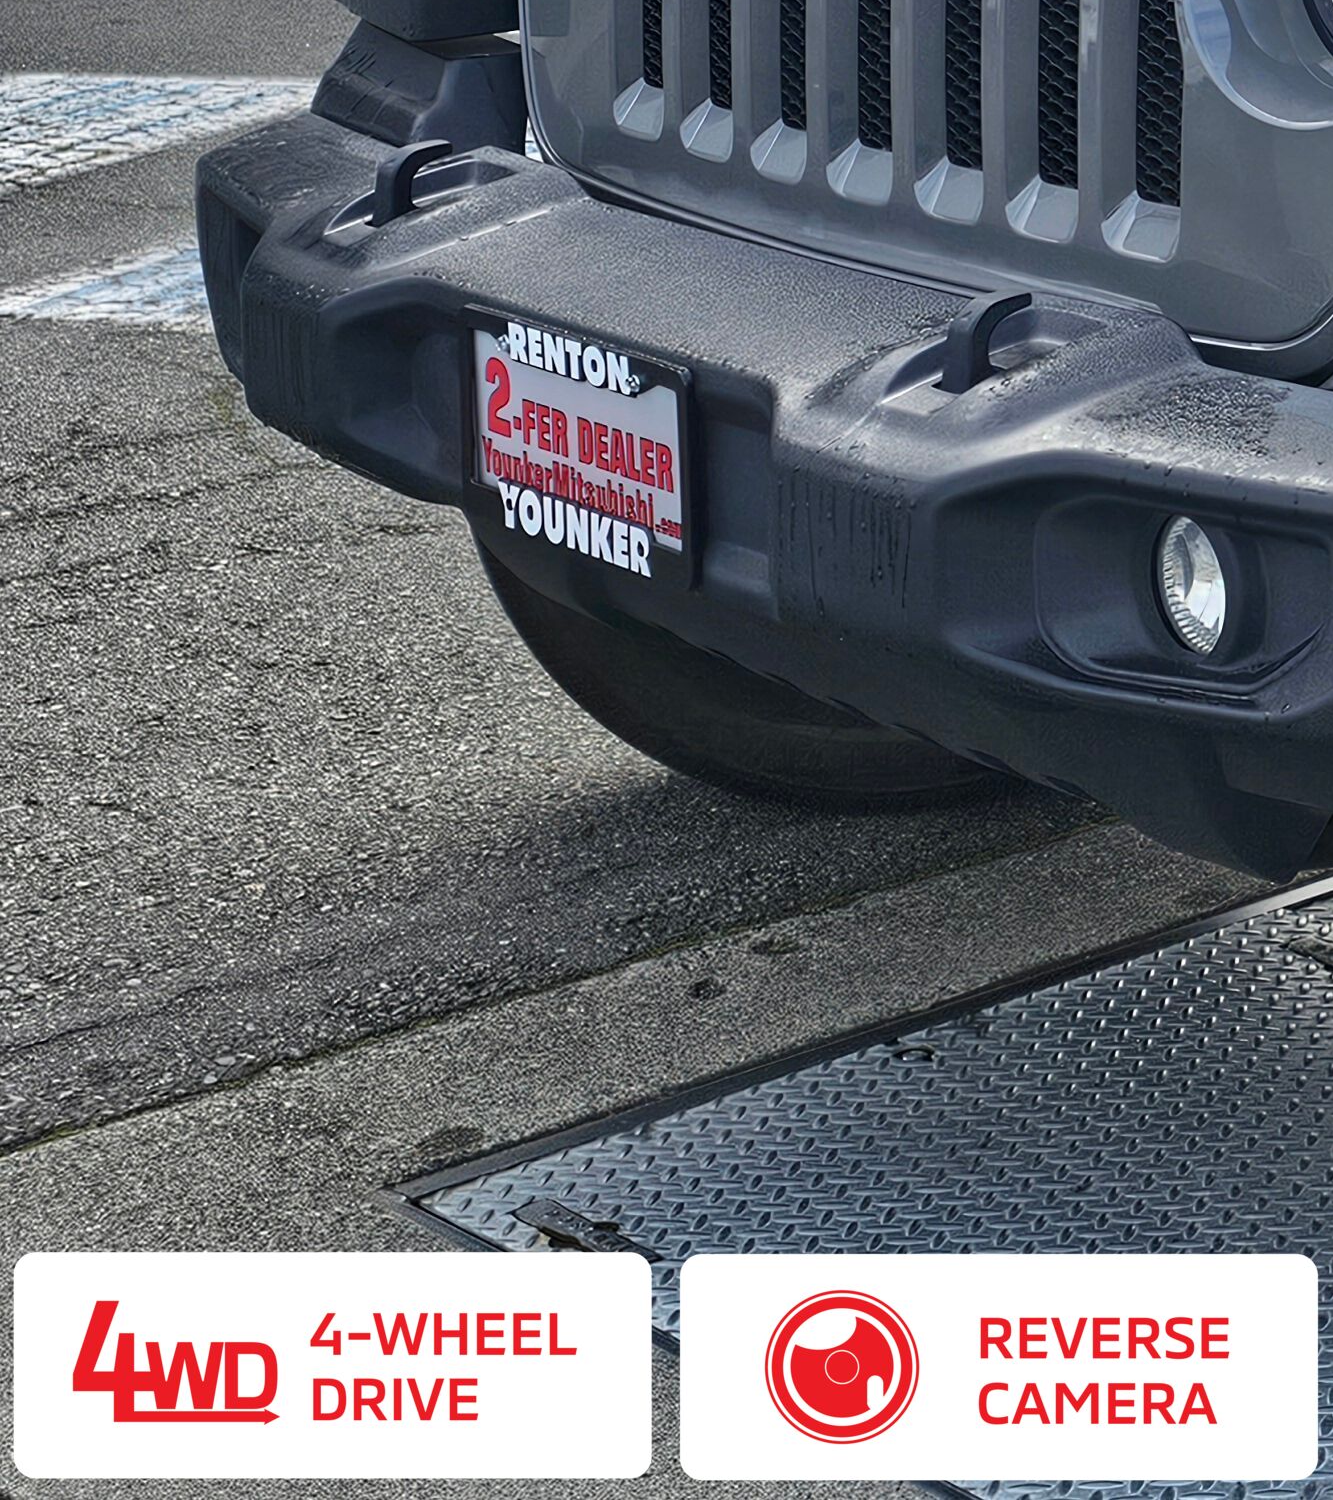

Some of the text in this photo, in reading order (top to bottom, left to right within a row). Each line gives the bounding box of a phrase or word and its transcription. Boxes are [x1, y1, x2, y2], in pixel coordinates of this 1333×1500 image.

[507, 321, 632, 396] RENTON
[485, 356, 675, 493] 2-FER DEALER
[498, 479, 652, 579] YOUNKER
